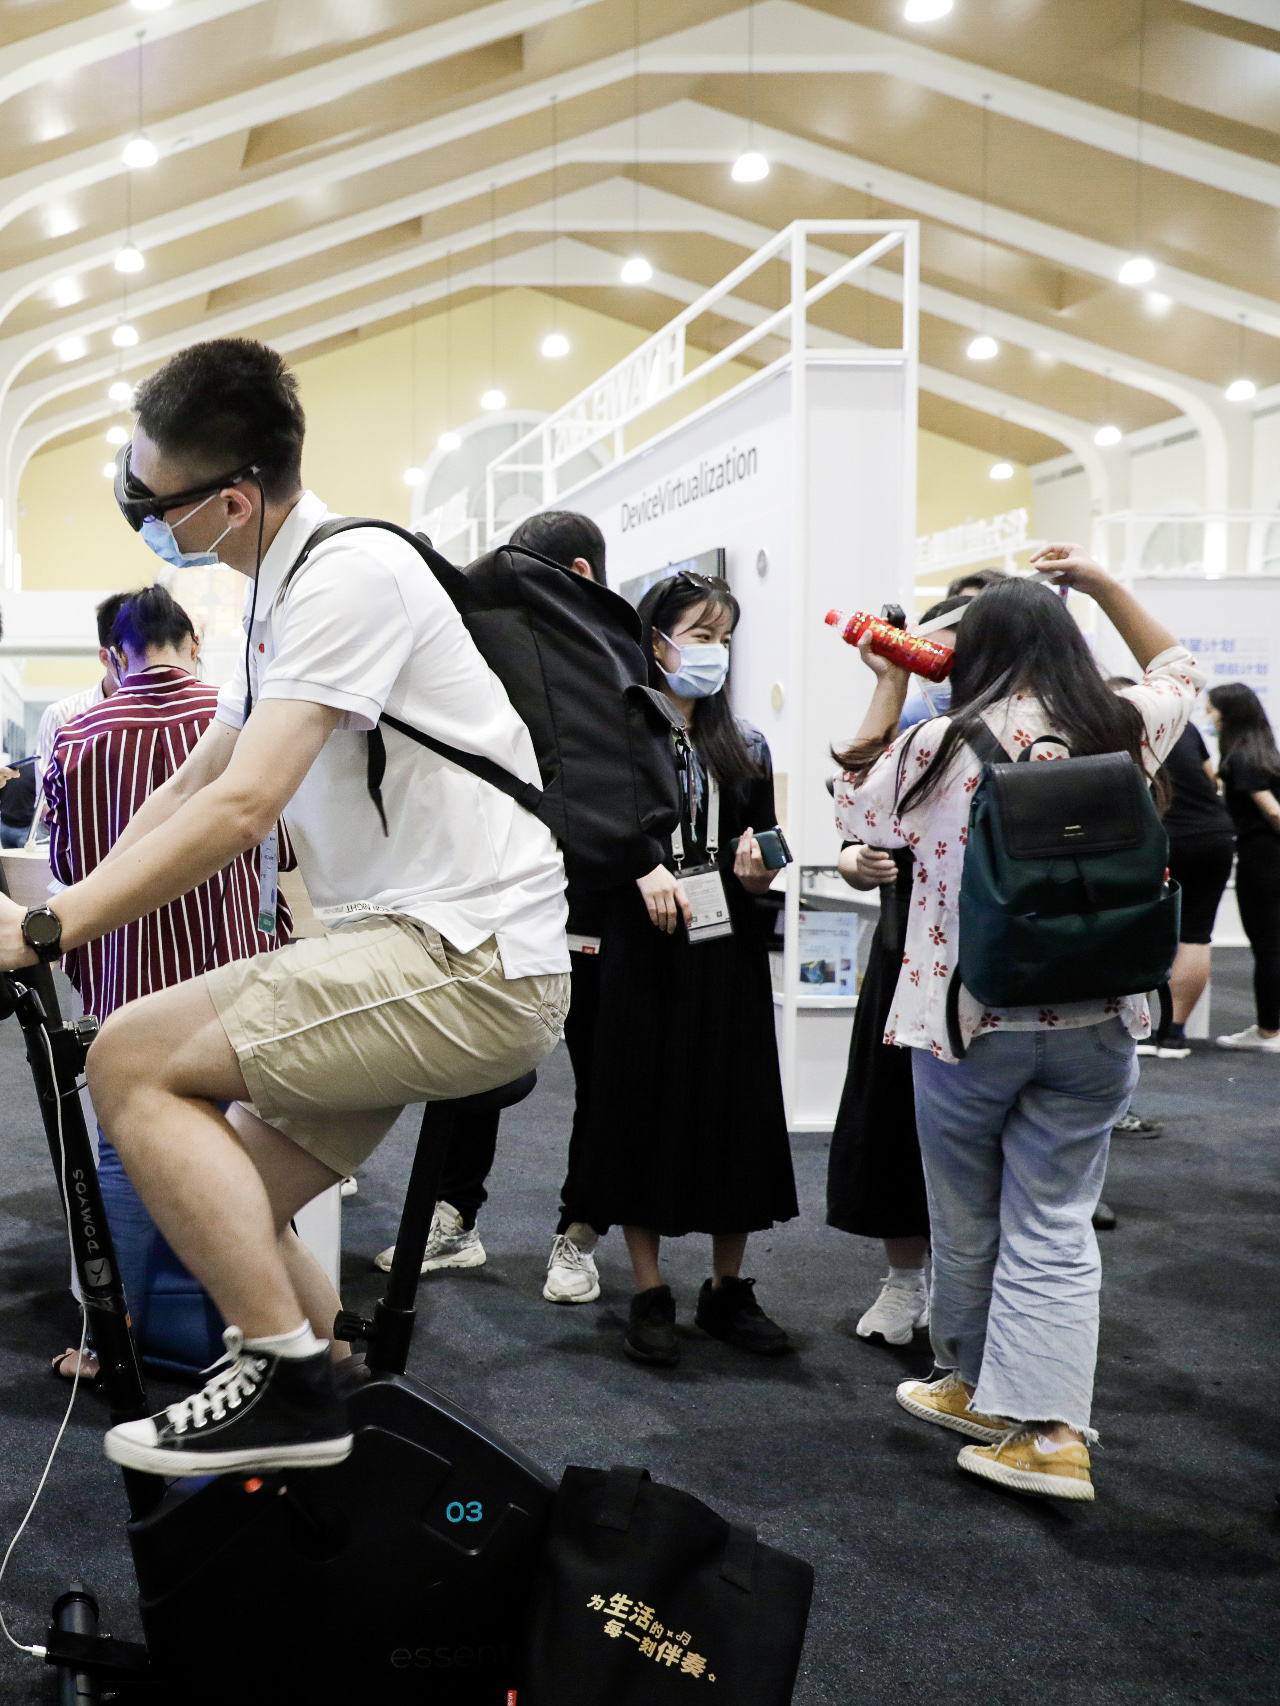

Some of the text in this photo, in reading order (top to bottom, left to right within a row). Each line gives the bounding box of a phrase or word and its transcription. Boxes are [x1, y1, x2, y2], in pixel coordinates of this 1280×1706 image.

[621, 446, 758, 532] DeviceVirtualization
[72, 1168, 100, 1255] DOMYOS
[445, 1501, 483, 1523] 03
[586, 1592, 665, 1639] 为生活的
